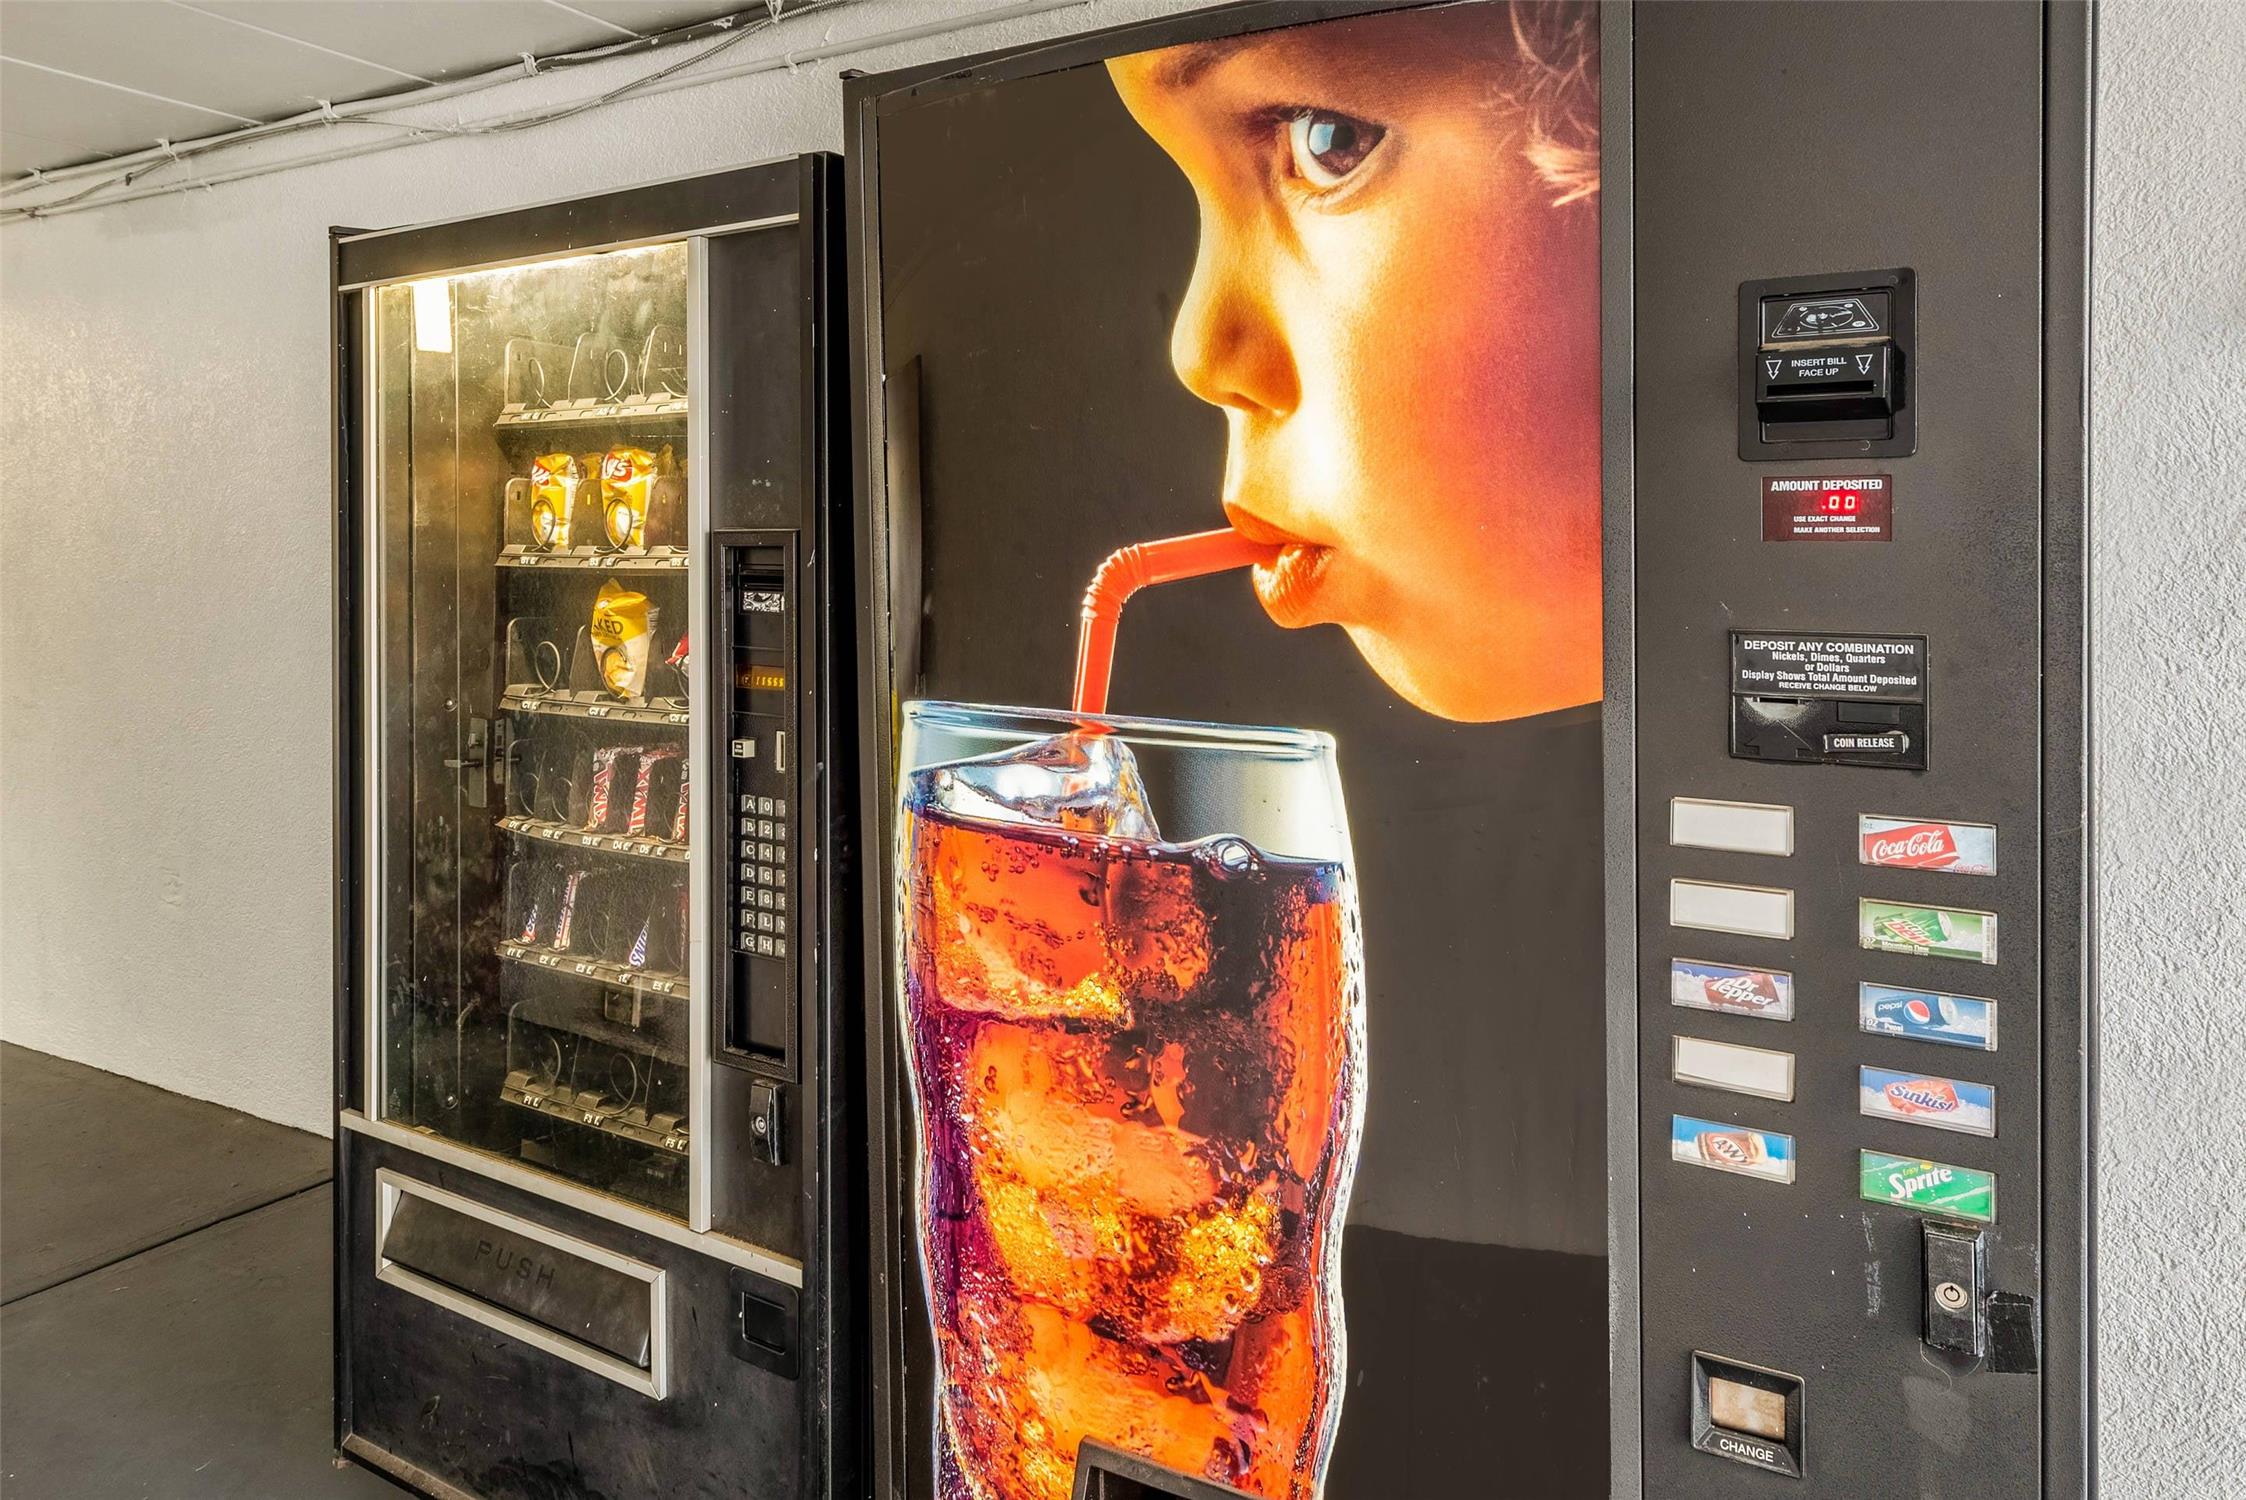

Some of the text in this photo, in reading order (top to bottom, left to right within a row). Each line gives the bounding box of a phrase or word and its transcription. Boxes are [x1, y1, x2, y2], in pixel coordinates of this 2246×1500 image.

[1791, 357, 1847, 367] INSERT BILL
[1799, 367, 1839, 377] FACE UP
[1771, 479, 1883, 492] AMOUNT DEPOSITED
[1744, 640, 1914, 655] DEPOSIT ANY COMBINATION
[1772, 651, 1886, 664] Nickels, Dimes, Quarters
[1817, 662, 1850, 673] Dollars
[1742, 669, 1917, 686] Display Shows Total Amount Deposited
[1779, 681, 1878, 693] RECEIVE CHANGE BELOW
[1834, 737, 1895, 748] COIN RELEASE
[747, 799, 754, 809] A
[747, 821, 770, 834] B 2
[746, 844, 770, 858] C 4
[746, 867, 754, 878] D
[746, 890, 770, 904] E 8
[746, 936, 754, 947] G
[1733, 977, 1759, 991] Dr
[1710, 978, 1774, 1005] Pepper
[1878, 1001, 1903, 1011] pepsi
[1890, 1084, 1953, 1112] Sunkist
[1889, 1166, 1953, 1199] Sprite
[474, 1240, 556, 1289] PUSH
[1719, 1438, 1774, 1462] CHANGE
